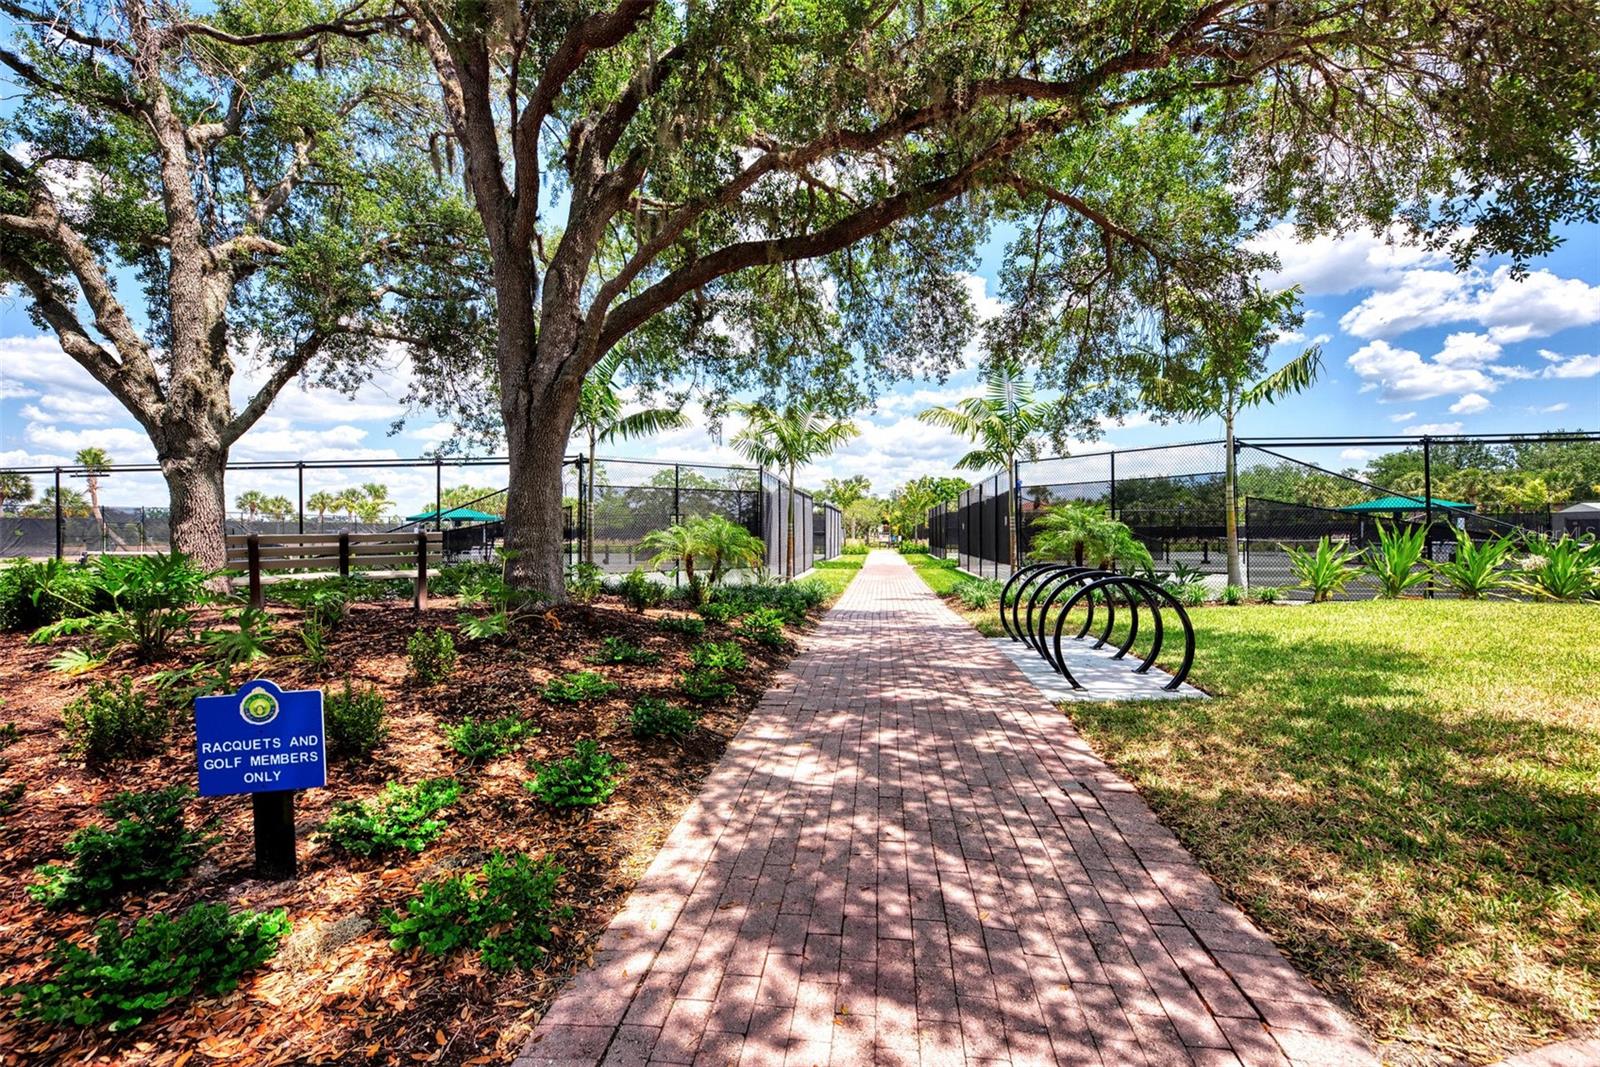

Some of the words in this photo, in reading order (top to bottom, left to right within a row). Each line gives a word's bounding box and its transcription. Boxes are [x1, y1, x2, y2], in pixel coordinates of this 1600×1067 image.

[202, 738, 281, 753] RACQUETS
[289, 735, 318, 747] AND
[204, 757, 242, 770] GOLF
[250, 752, 318, 766] MEMBERS
[243, 771, 281, 783] ONLY
